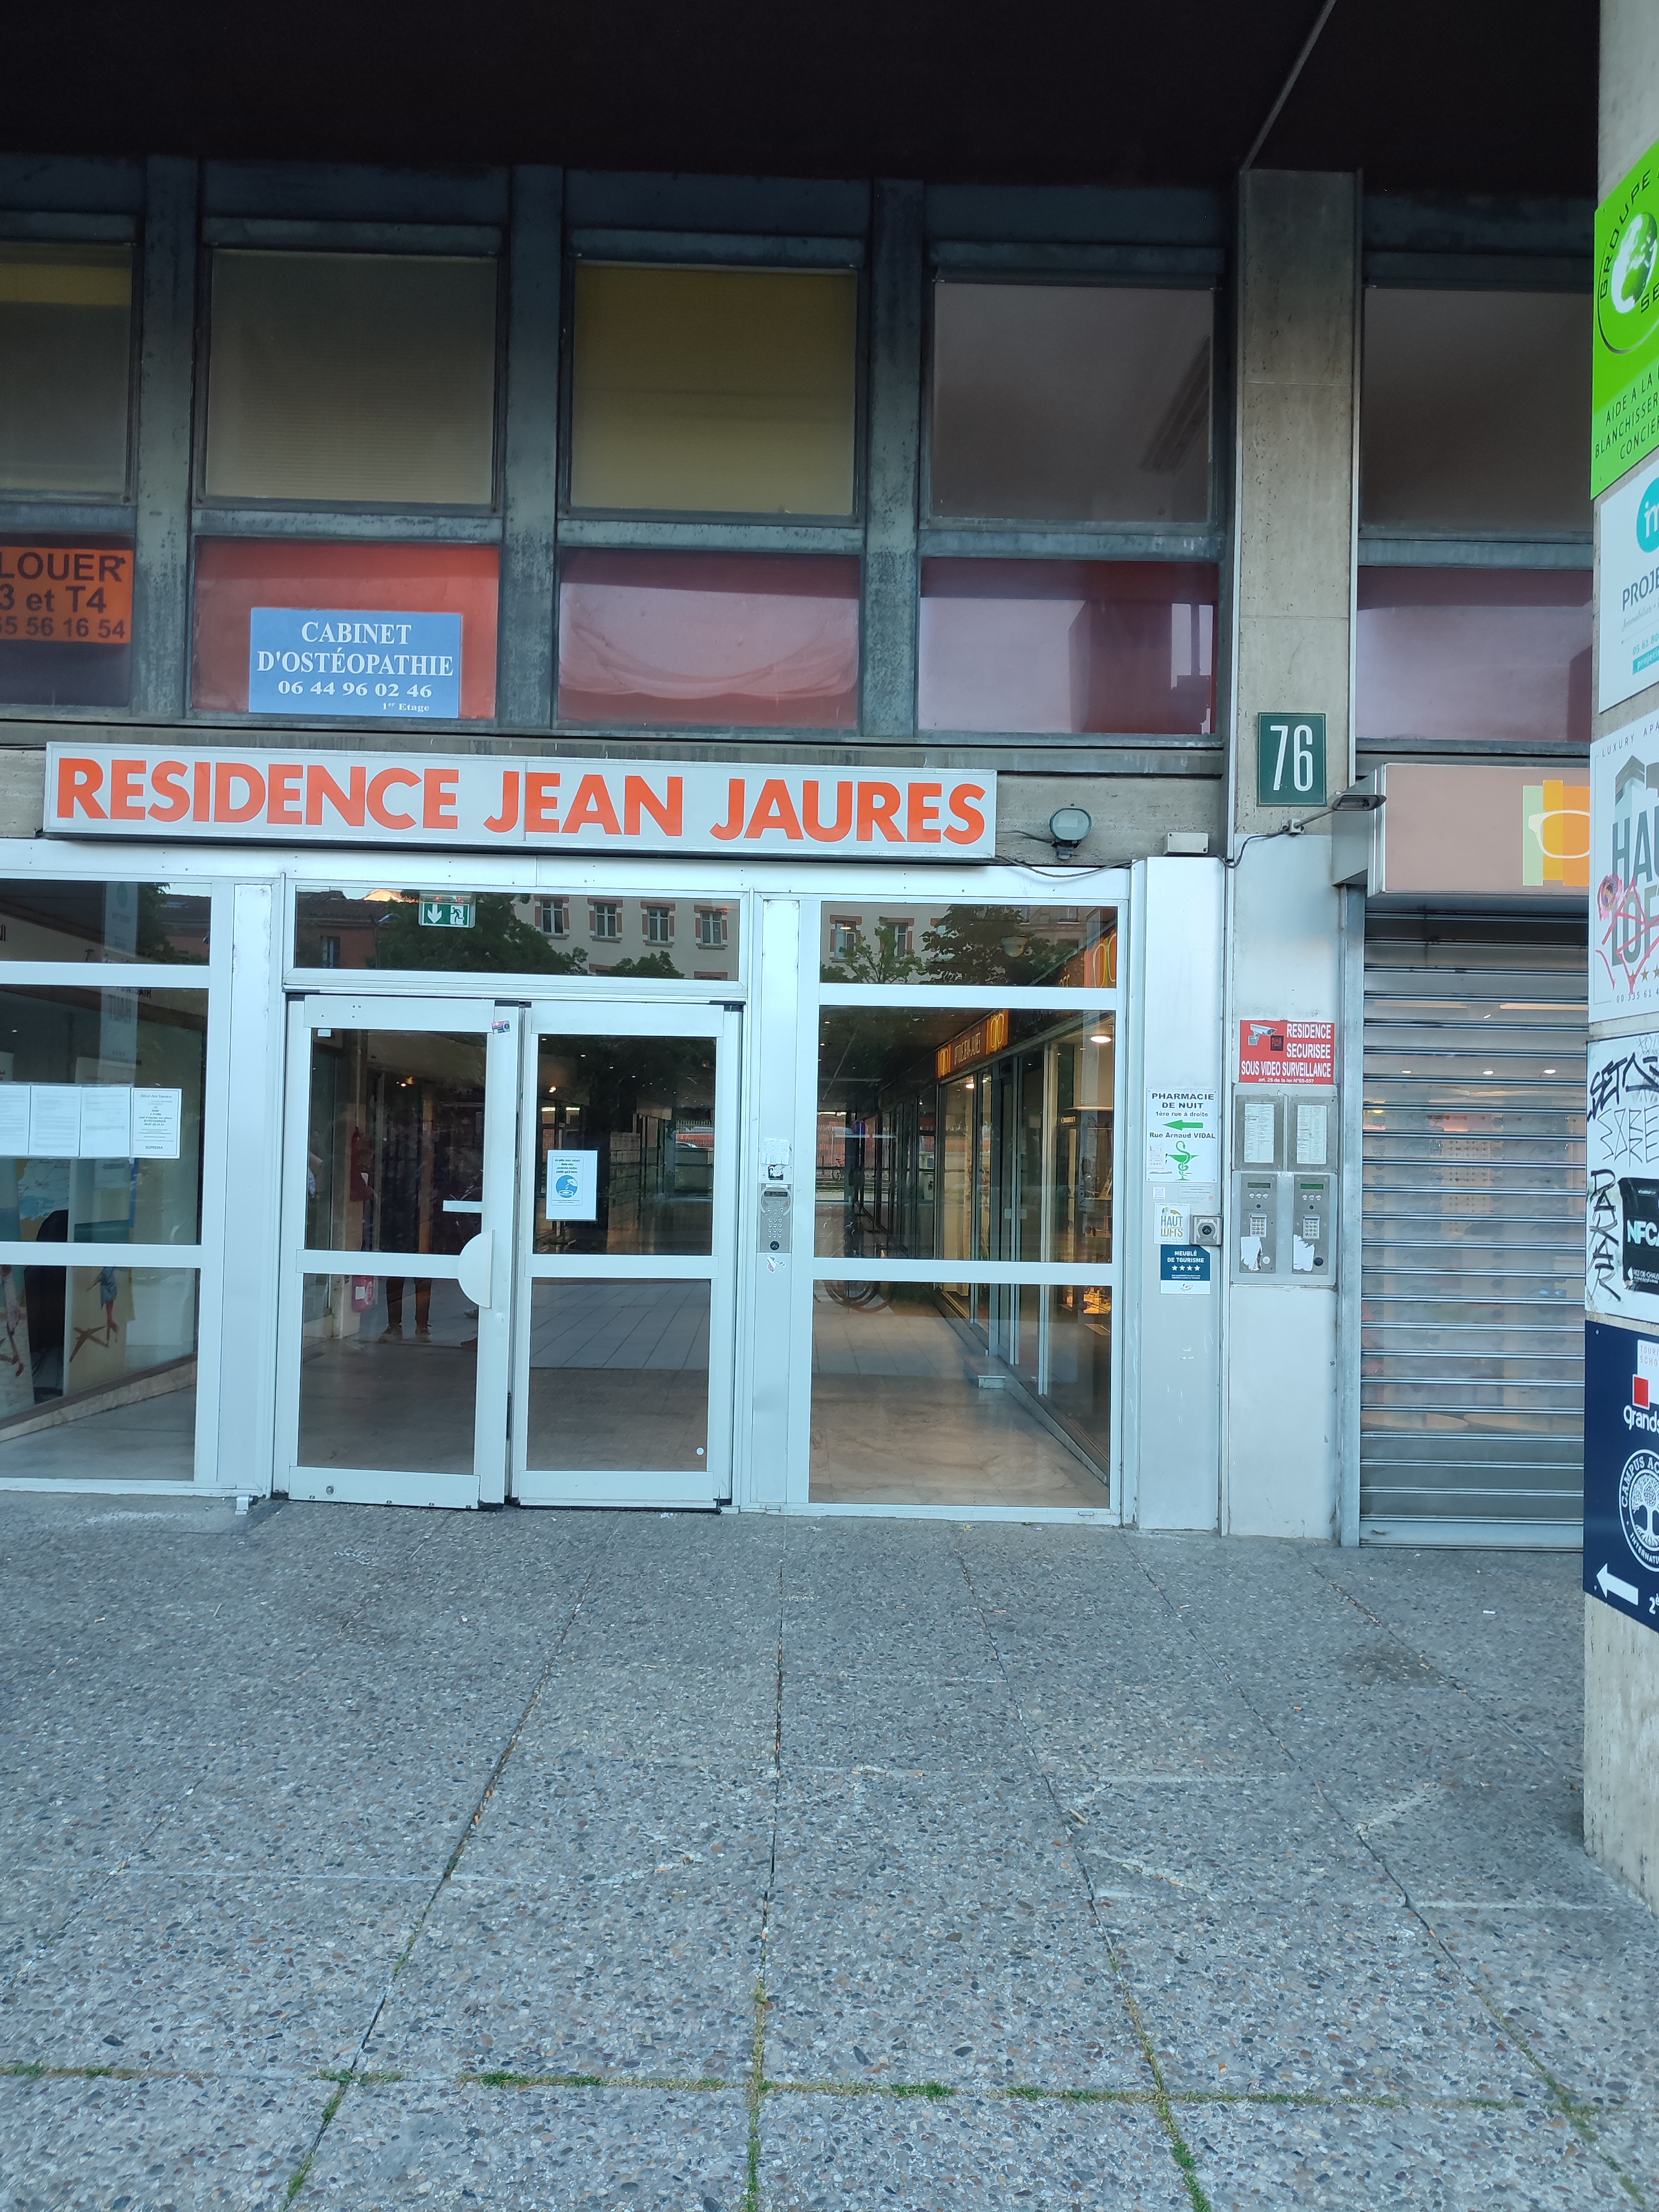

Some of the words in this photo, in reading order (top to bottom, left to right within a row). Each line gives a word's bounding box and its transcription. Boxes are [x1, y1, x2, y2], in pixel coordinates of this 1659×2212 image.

[1600, 169, 1651, 299] GROUPE
[1605, 394, 1627, 426] AIDE
[1631, 387, 1636, 404] A
[1641, 372, 1652, 394] LA
[26, 589, 55, 612] et
[65, 586, 107, 613] T4
[0, 616, 18, 635] 5
[27, 617, 54, 637] 56
[63, 618, 90, 637] 16
[98, 619, 125, 639] 54
[301, 621, 411, 645] CABINET
[257, 647, 453, 676] D'OSTÉOPATHIE
[278, 681, 304, 695] 06
[310, 681, 335, 696] 44
[342, 682, 368, 696] 96
[375, 684, 399, 697] 02
[406, 684, 432, 698] 46
[399, 703, 430, 713] Etage
[1602, 733, 1635, 758] LUXURY
[1270, 724, 1314, 792] 76
[57, 758, 459, 830] RESIDENCE
[483, 770, 683, 837] JEAN
[709, 778, 986, 846] JAURES
[1286, 1023, 1332, 1039] RESIDENCE
[1286, 1043, 1331, 1059] SECURISEE
[1241, 1060, 1260, 1076] SOUS
[1260, 1061, 1281, 1076] VIDEO
[1282, 1061, 1331, 1078] SURVEILLANCE
[1161, 1215, 1183, 1226] HAUT
[1161, 1227, 1183, 1238] LOFTS
[1627, 1219, 1659, 1248] NFC
[1621, 1455, 1645, 1508] CAMPUS
